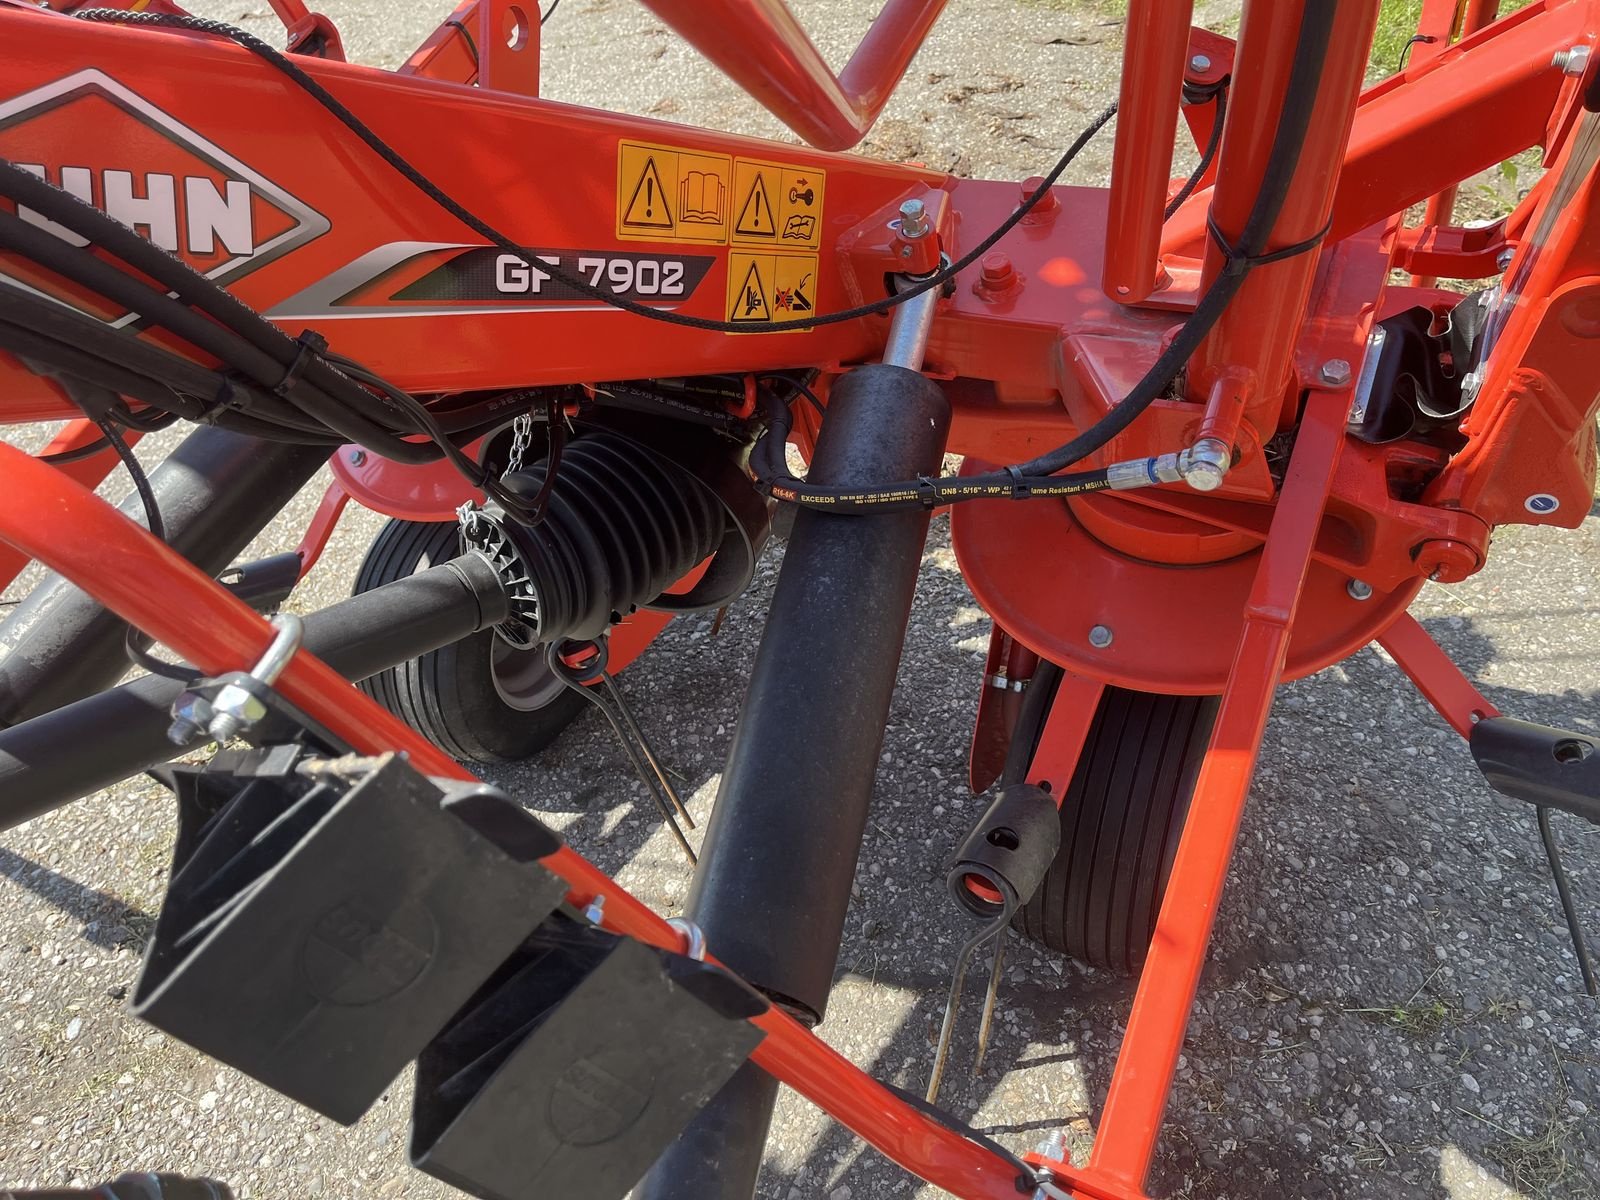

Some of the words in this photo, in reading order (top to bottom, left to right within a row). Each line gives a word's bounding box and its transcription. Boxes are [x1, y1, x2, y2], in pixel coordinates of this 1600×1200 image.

[15, 162, 253, 255] UHN
[495, 253, 560, 294] GF
[578, 256, 686, 296] 7902
[941, 487, 957, 495] DN8
[963, 486, 982, 495] 5/16"
[987, 486, 1000, 494] WP
[1048, 485, 1080, 494] Resistant
[1084, 480, 1104, 490] MSHA
[800, 494, 835, 504] EXCEEDS
